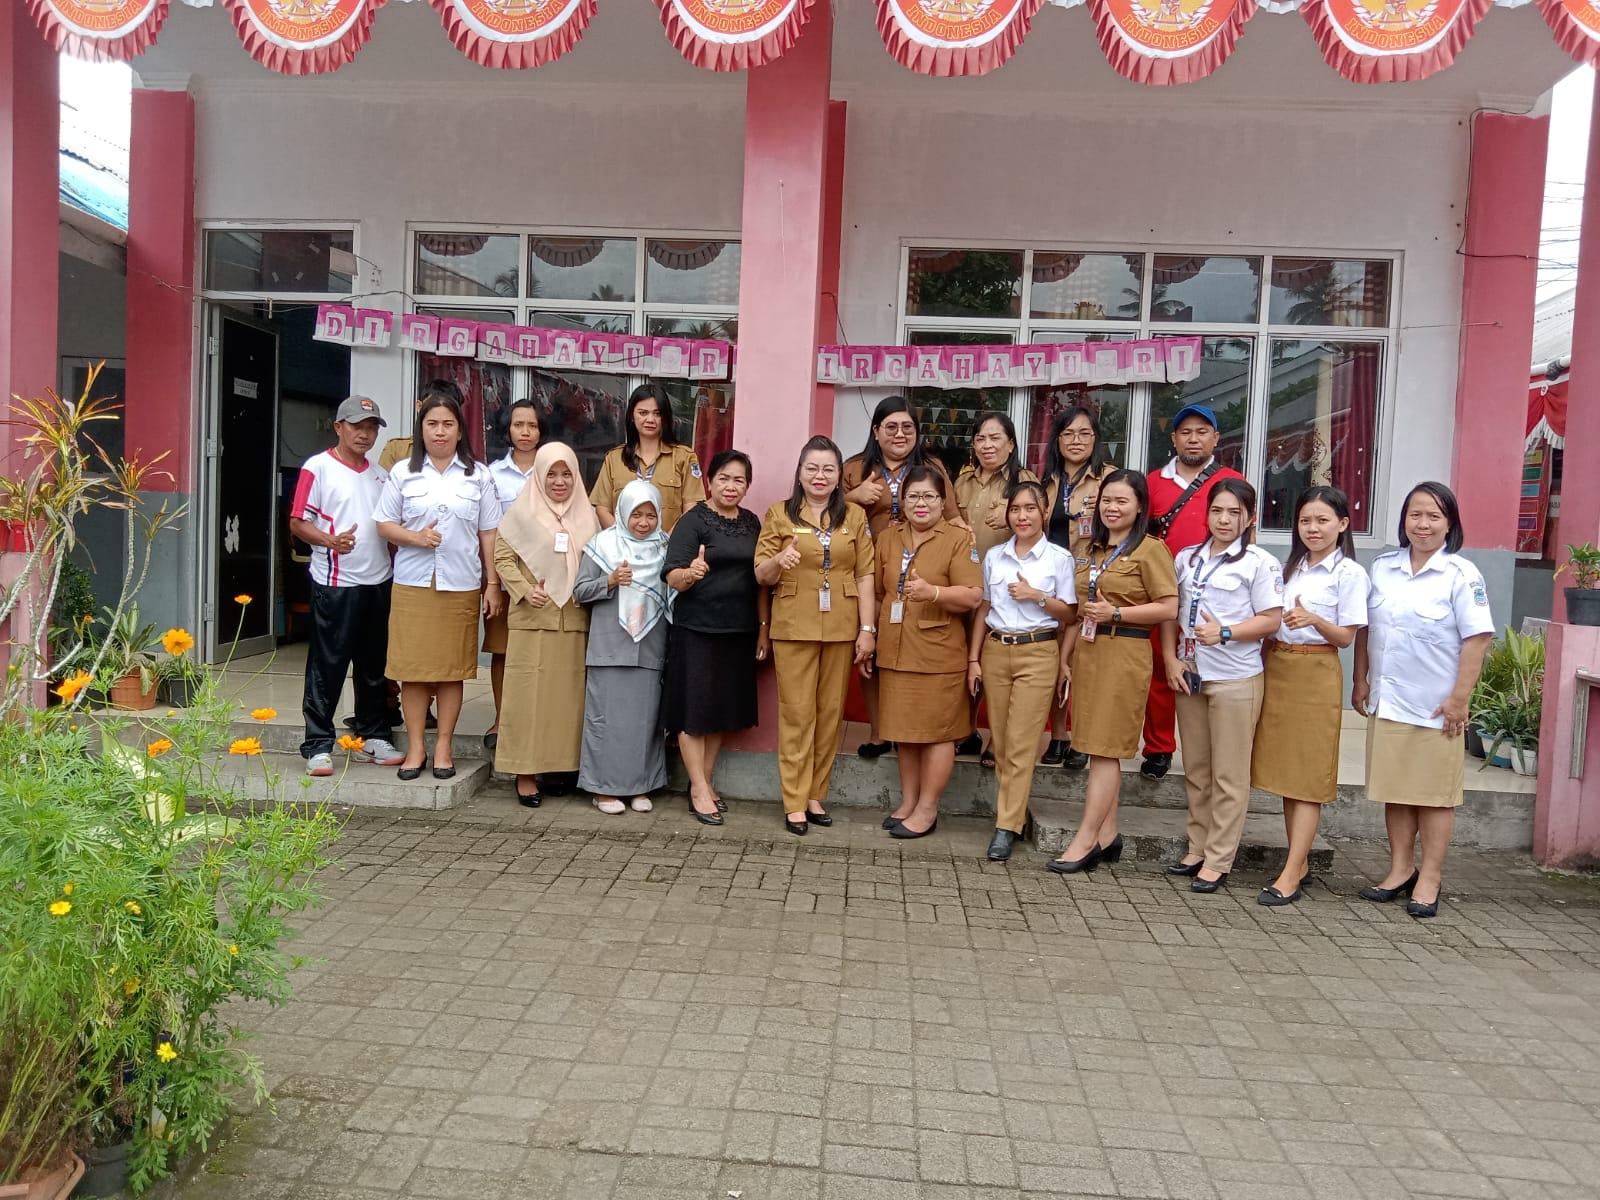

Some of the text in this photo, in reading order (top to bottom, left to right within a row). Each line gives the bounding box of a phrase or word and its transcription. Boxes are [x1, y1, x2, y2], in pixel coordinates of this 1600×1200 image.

[56, 0, 141, 28] INDONESIA
[259, 8, 348, 40] INDONESIA
[471, 1, 563, 32] INDONESIA
[688, 1, 782, 32] INDONESIA
[906, 6, 1001, 39] INDONESIA
[1121, 14, 1219, 48] INDONESIA
[1345, 15, 1445, 48] INDONESIA
[326, 316, 641, 368] DIRGAHAYU
[1137, 350, 1185, 374] RI
